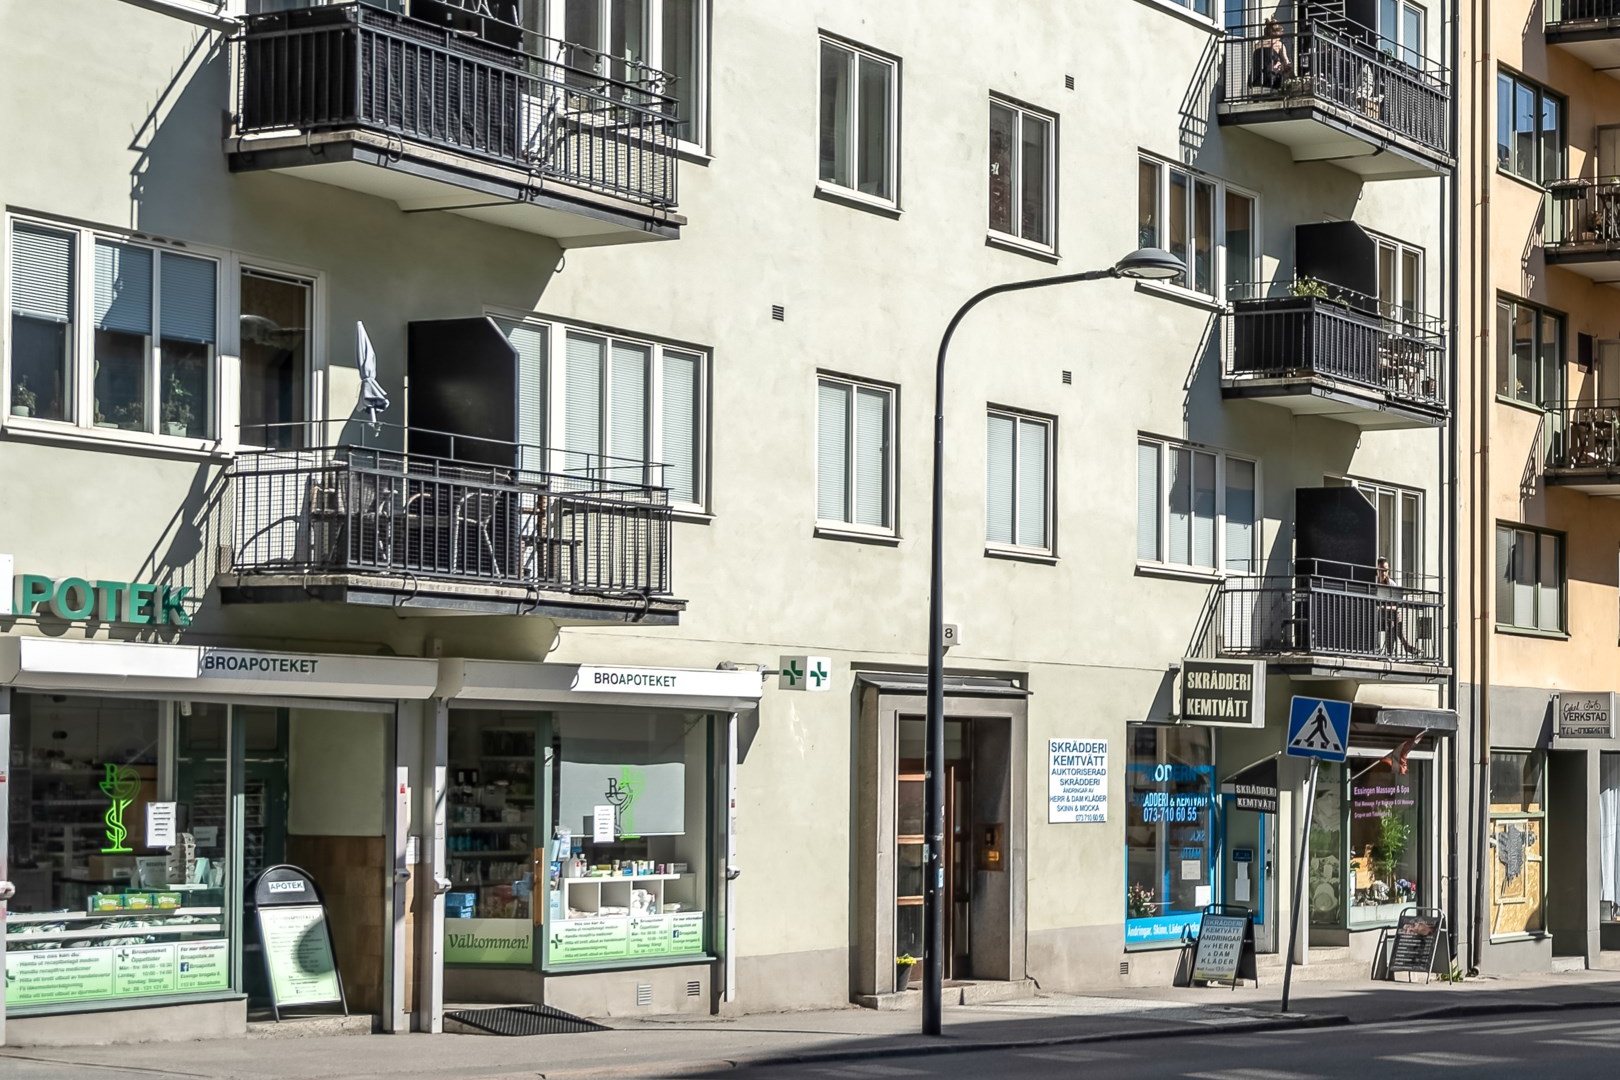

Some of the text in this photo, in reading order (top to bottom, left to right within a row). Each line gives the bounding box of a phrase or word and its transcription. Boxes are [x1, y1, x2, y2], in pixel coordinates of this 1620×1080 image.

[13, 574, 192, 626] POTEK
[944, 627, 953, 638] 8
[204, 656, 318, 673] BROAPOTEKET
[594, 672, 677, 687] BROAPOTEKET
[1187, 670, 1251, 691] SKRÄDDERI
[1186, 697, 1248, 717] KEMTVÄTT
[1563, 712, 1607, 721] VERKSTAD
[1051, 740, 1107, 753] SKRÄDDERI
[1053, 753, 1105, 766] KEMTVÄTT
[1051, 768, 1107, 776] AUKTORISERAD
[1059, 777, 1101, 786] SKRÄDDERI
[1235, 784, 1277, 797] SKRÄDDERI
[1401, 785, 1410, 795] Spa
[1079, 804, 1100, 812] MOCKA
[1236, 797, 1276, 811] KEMTVÄTT
[1143, 807, 1197, 822] 073-710 60 55
[270, 880, 303, 890] APOTEK
[448, 933, 529, 949] Välkommen!
